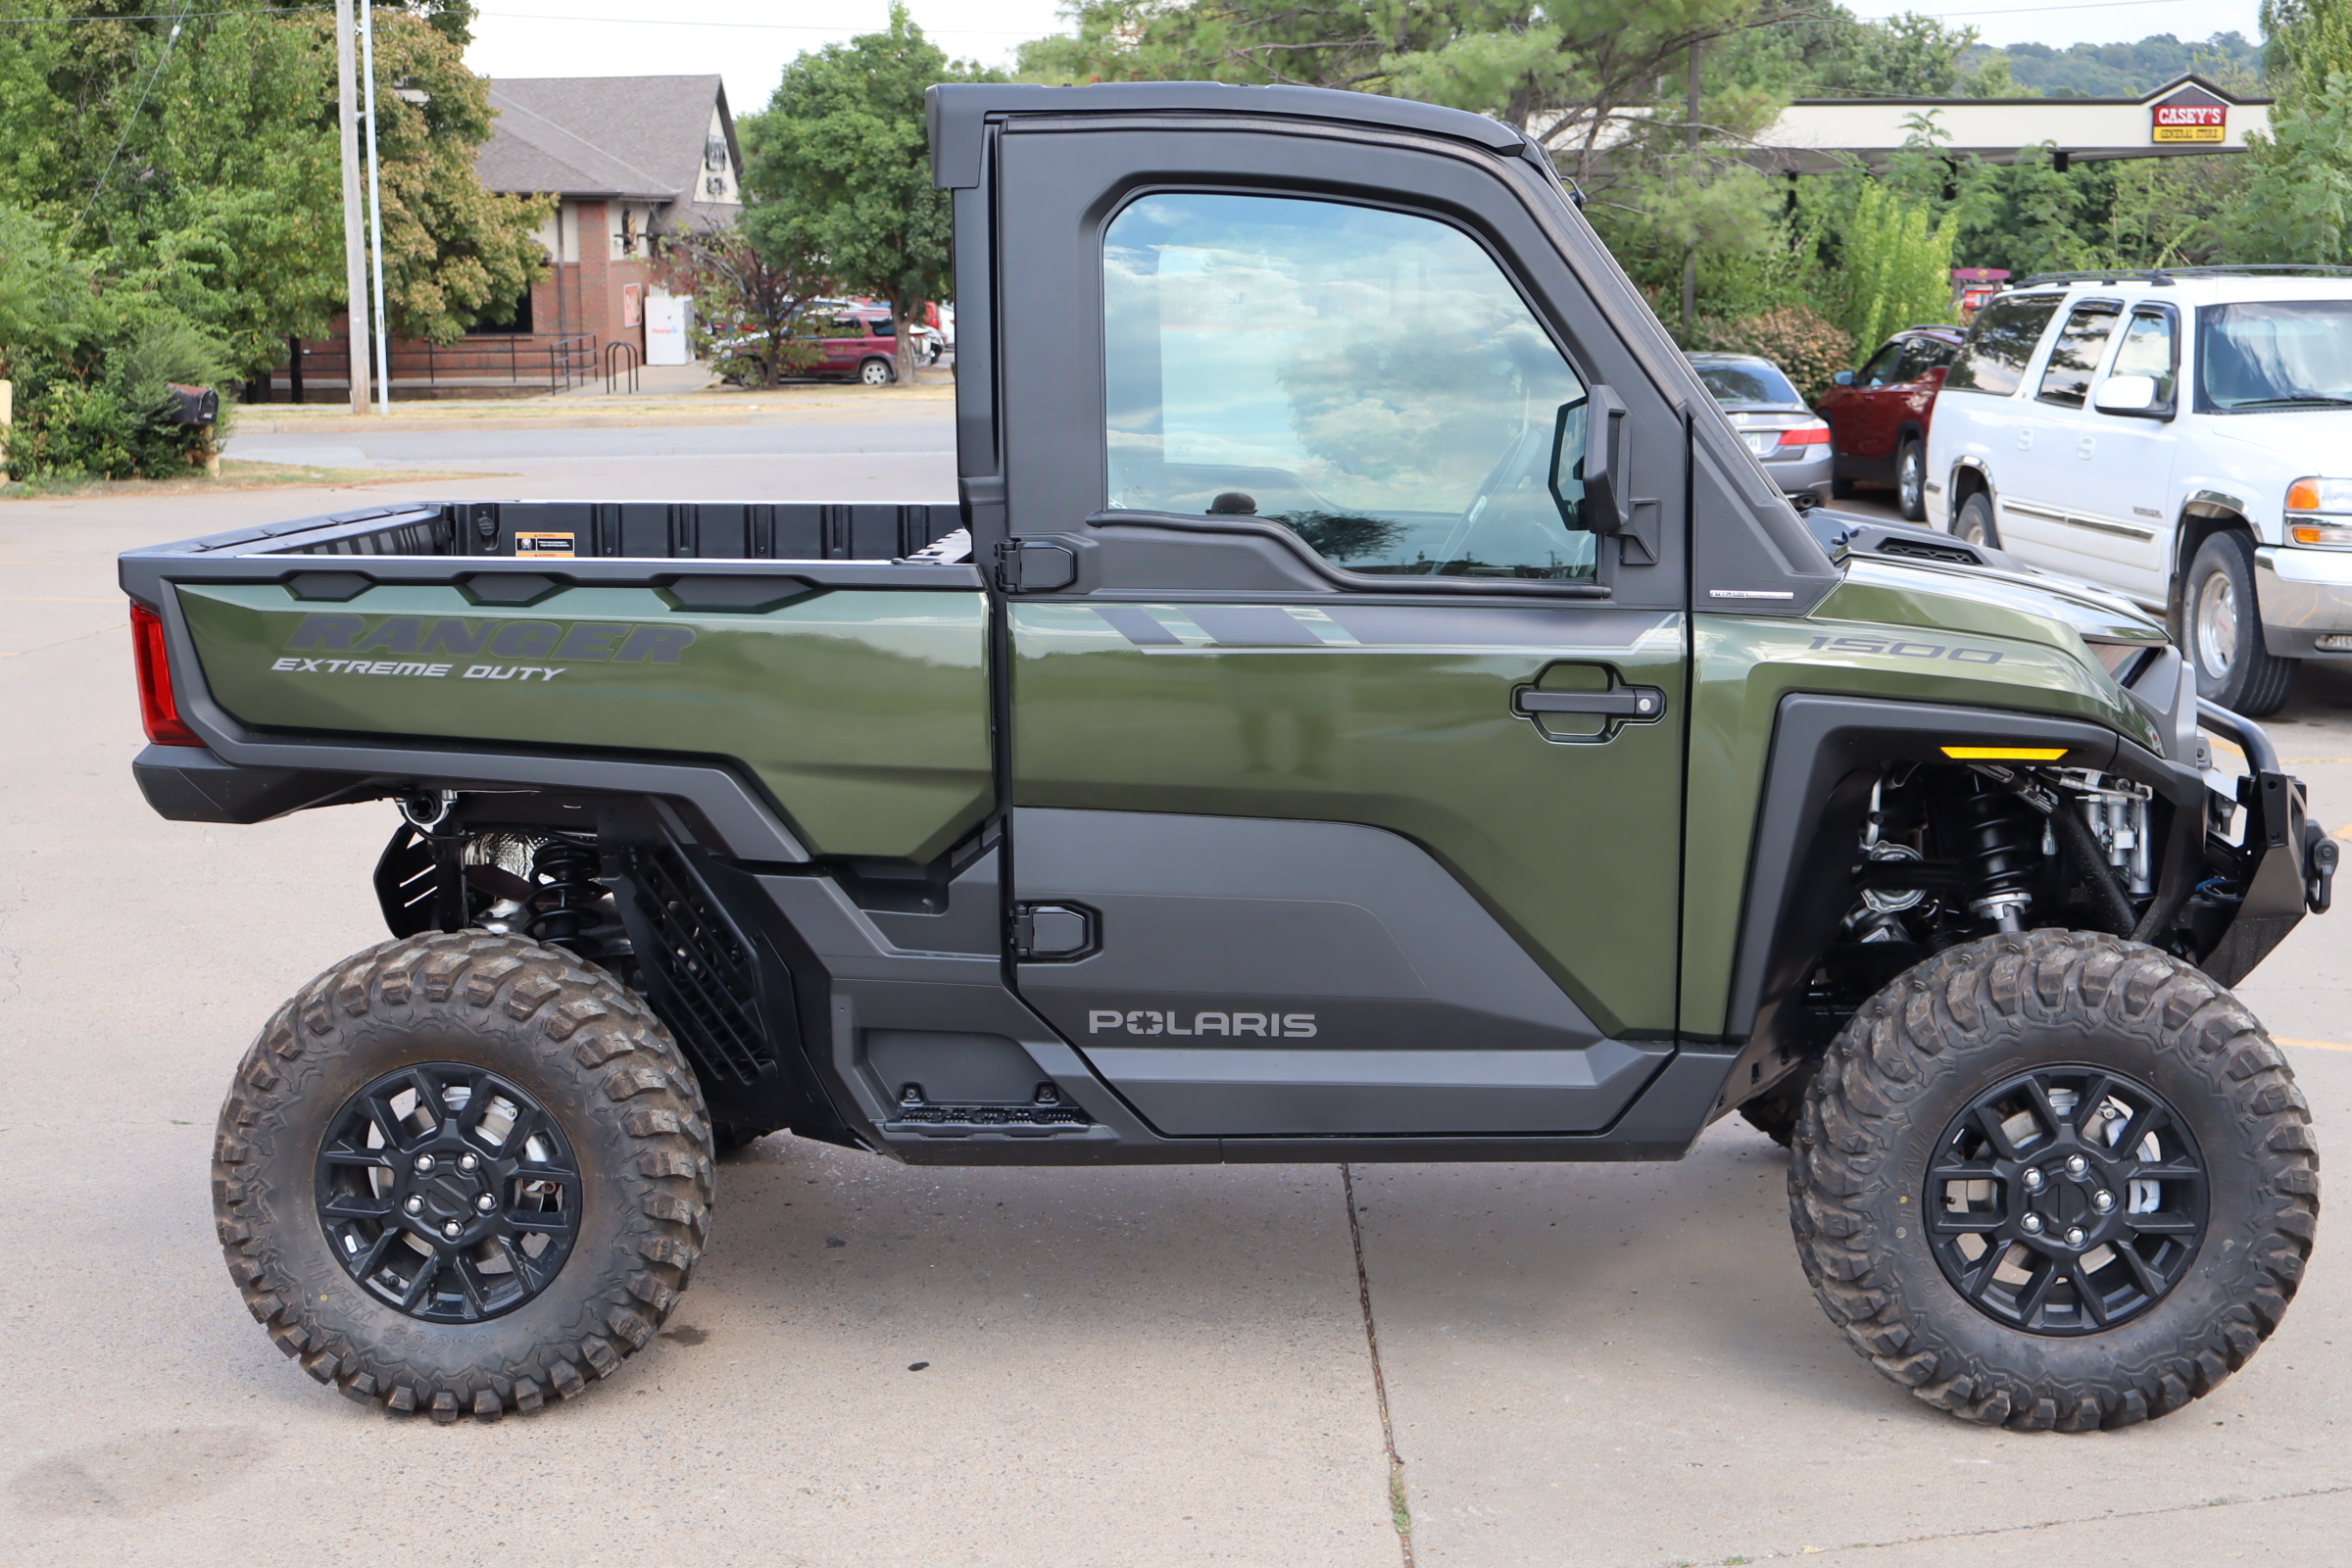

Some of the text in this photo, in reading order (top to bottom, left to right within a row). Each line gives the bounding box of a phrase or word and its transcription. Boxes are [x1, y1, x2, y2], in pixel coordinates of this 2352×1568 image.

[2158, 108, 2222, 124] CASEY'S
[283, 613, 697, 664] RANGER
[1808, 636, 2005, 665] 1500
[271, 657, 567, 681] EXTREME DUTY
[1089, 1009, 1318, 1038] POLARIS
[302, 1250, 378, 1330] TRAIL
